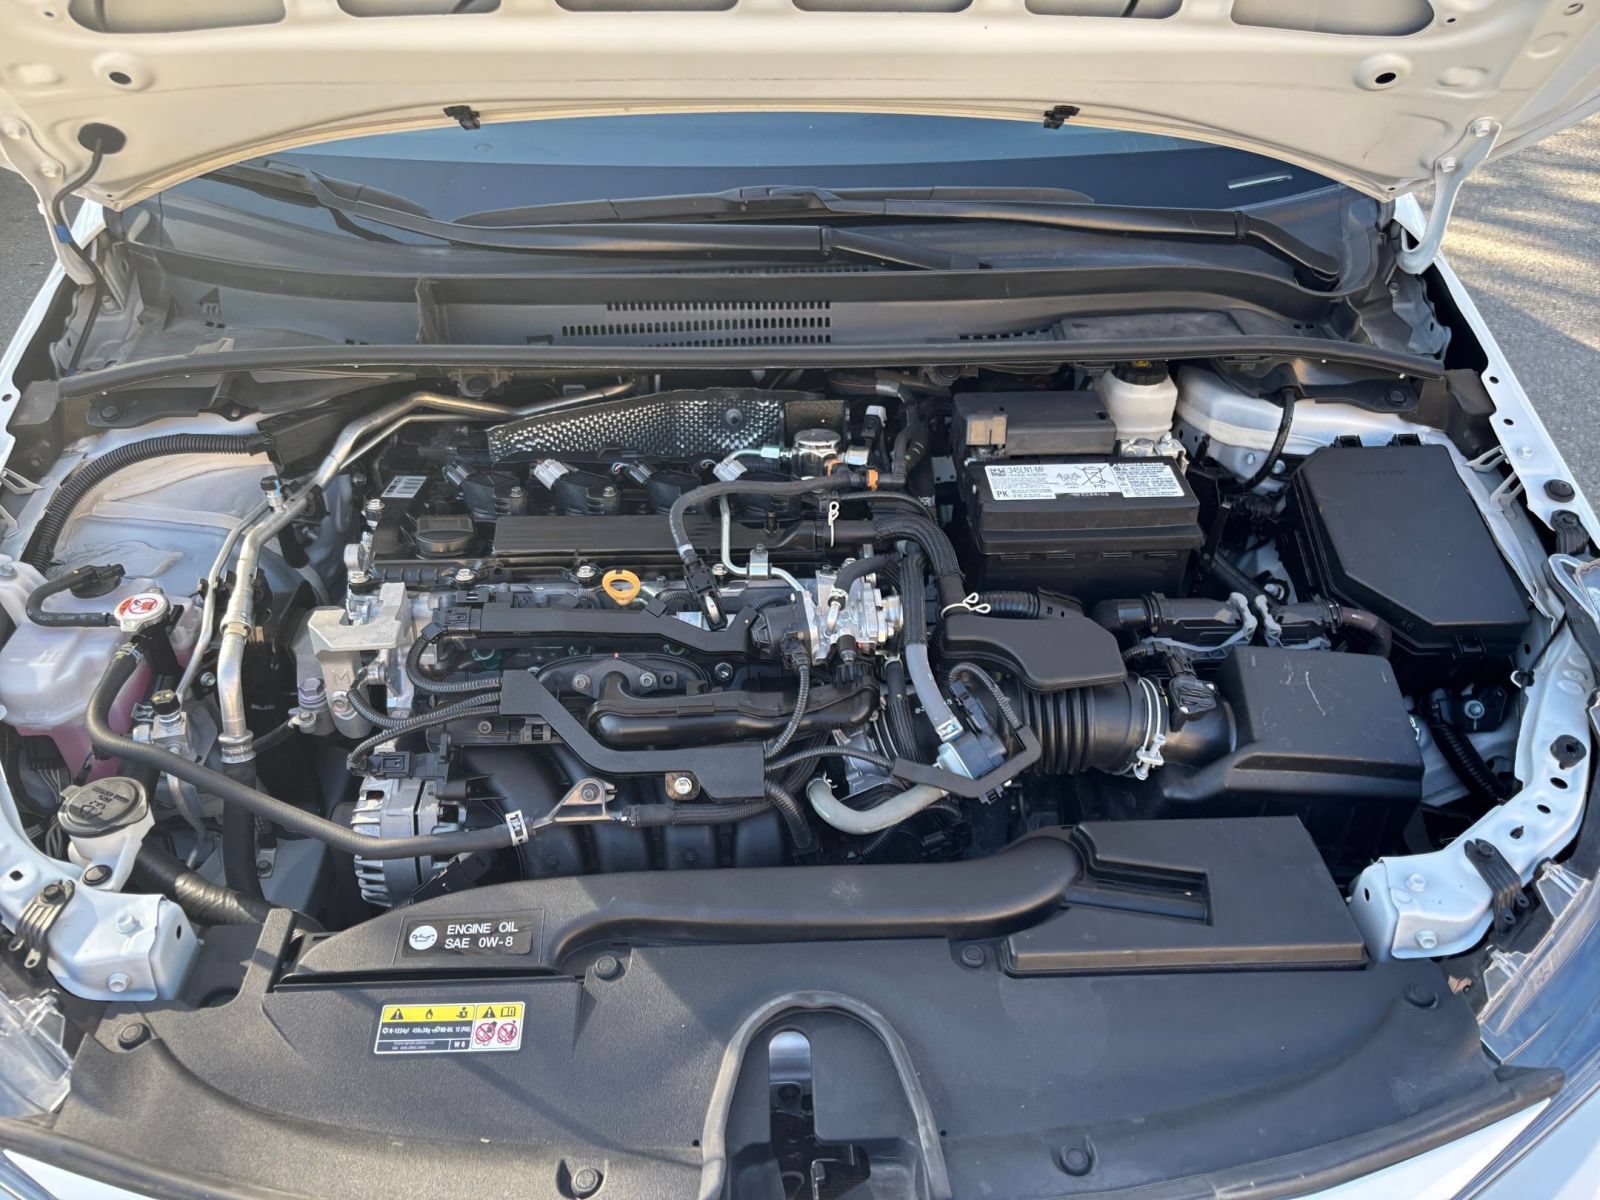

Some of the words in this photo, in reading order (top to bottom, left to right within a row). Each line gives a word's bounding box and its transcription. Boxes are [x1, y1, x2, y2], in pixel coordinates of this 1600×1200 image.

[996, 490, 1009, 498] PK
[446, 922, 492, 935] ENGINE
[498, 921, 519, 933] OIL
[444, 937, 471, 949] SAE
[478, 935, 514, 949] 0W-8
